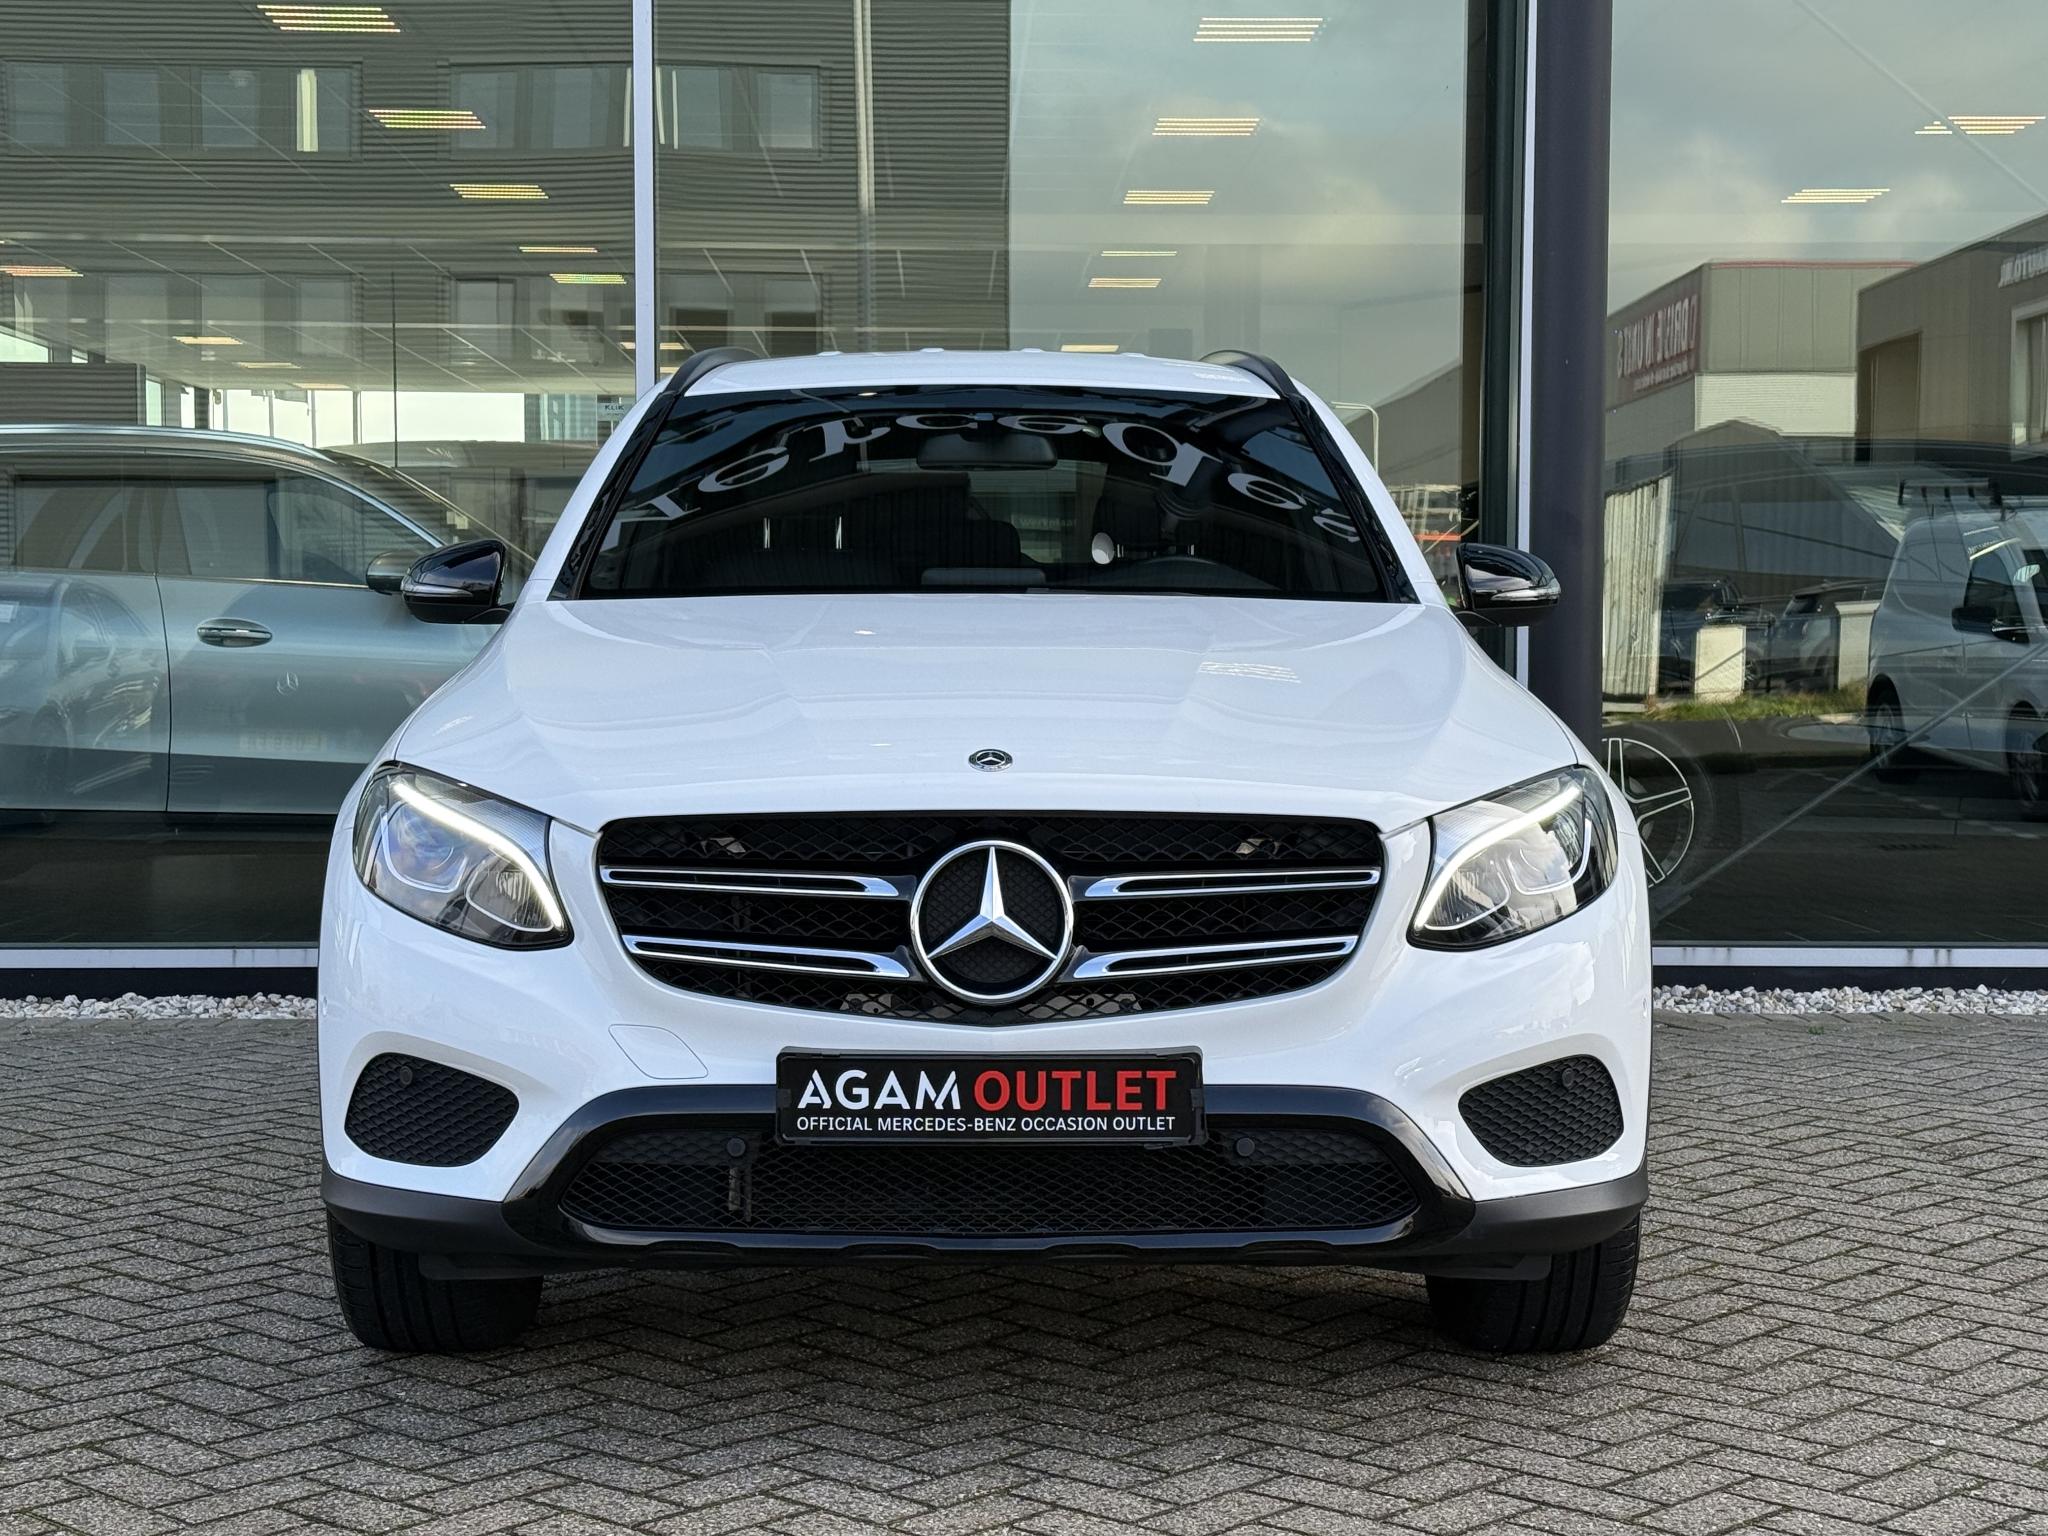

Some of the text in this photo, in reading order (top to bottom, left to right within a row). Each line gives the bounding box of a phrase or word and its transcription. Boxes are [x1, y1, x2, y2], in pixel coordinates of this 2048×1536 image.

[797, 1069, 1177, 1111] AGAM OUTLET
[797, 1116, 1176, 1132] OFFICIAL MERCEDES-BENZ OCCASION OUTLET
